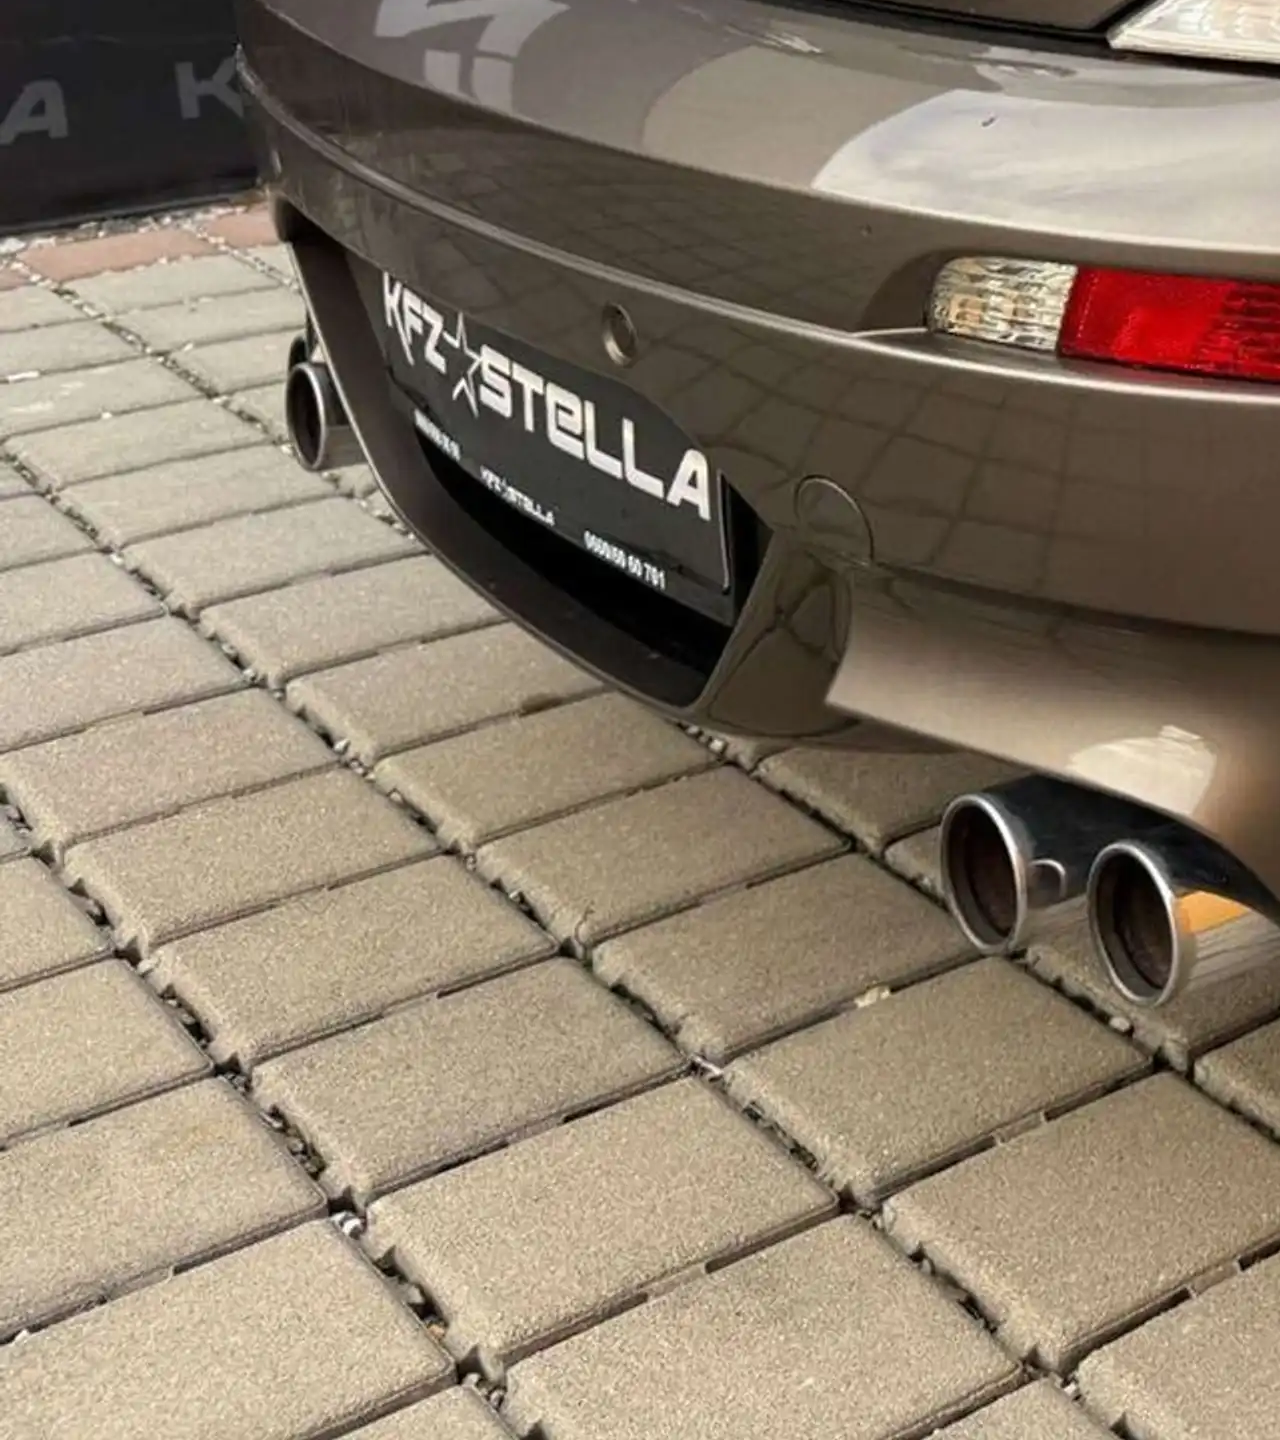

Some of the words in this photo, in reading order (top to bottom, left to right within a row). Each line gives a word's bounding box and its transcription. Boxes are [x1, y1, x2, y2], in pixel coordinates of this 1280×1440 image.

[0, 78, 71, 146] A
[384, 271, 447, 375] KFZ
[479, 344, 711, 522] STELLA
